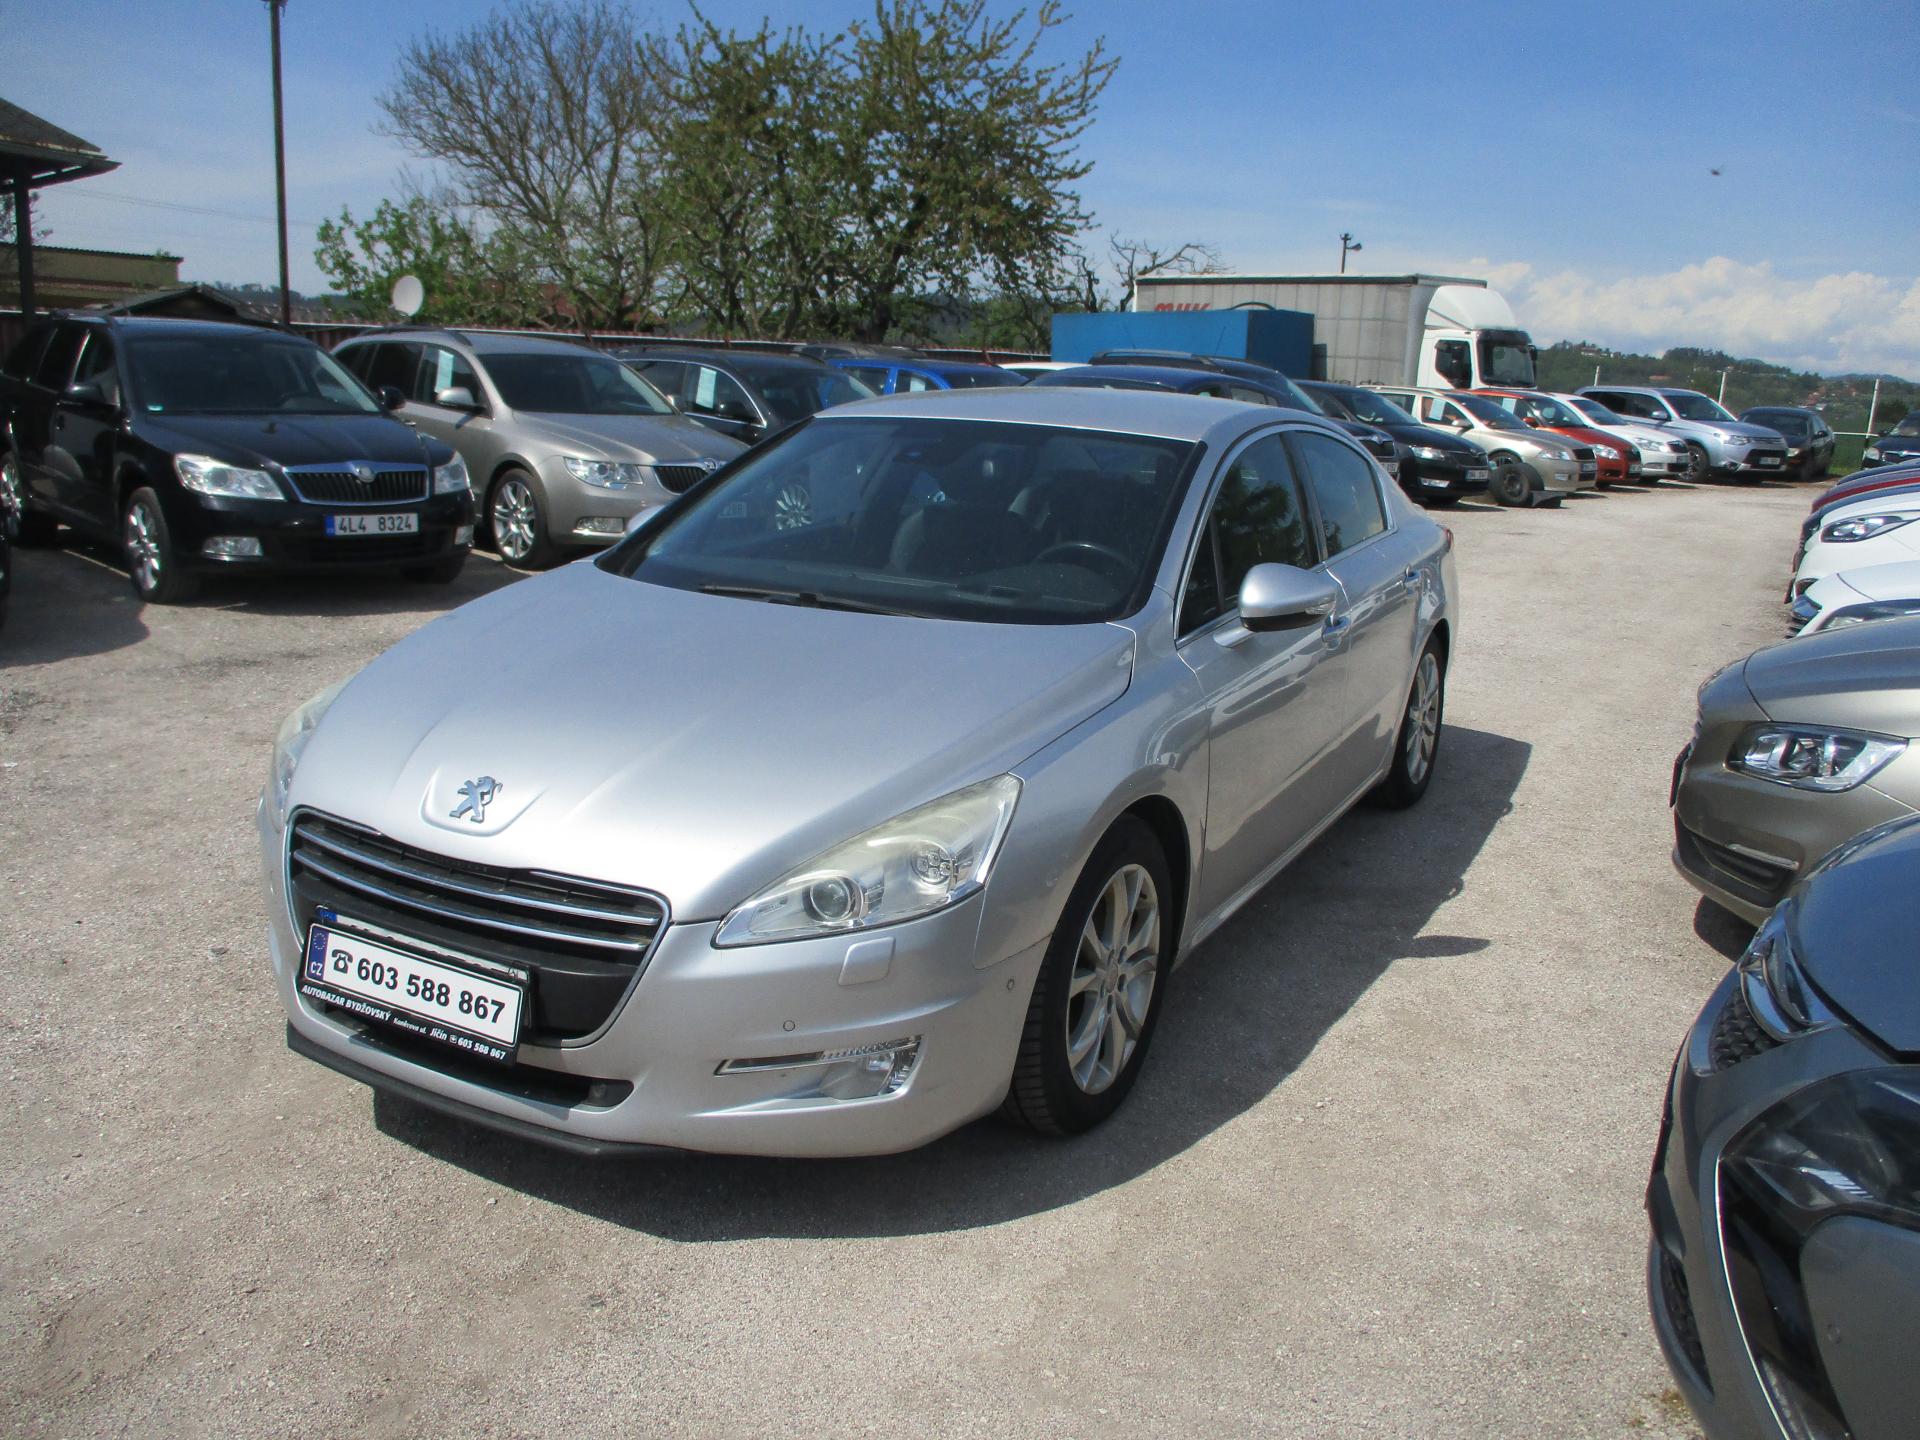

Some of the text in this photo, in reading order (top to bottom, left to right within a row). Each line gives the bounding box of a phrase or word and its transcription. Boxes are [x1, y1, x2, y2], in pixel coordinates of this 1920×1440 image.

[339, 516, 412, 533] 4L4 8324
[310, 962, 323, 976] CZ
[357, 958, 506, 1024] 603 588 867
[301, 985, 346, 1006] AUTOBAZAR
[345, 1000, 392, 1021] BYDŽOVSKÝ
[458, 1037, 473, 1049] 603
[473, 1043, 490, 1055] 588
[490, 1048, 506, 1060] 867
